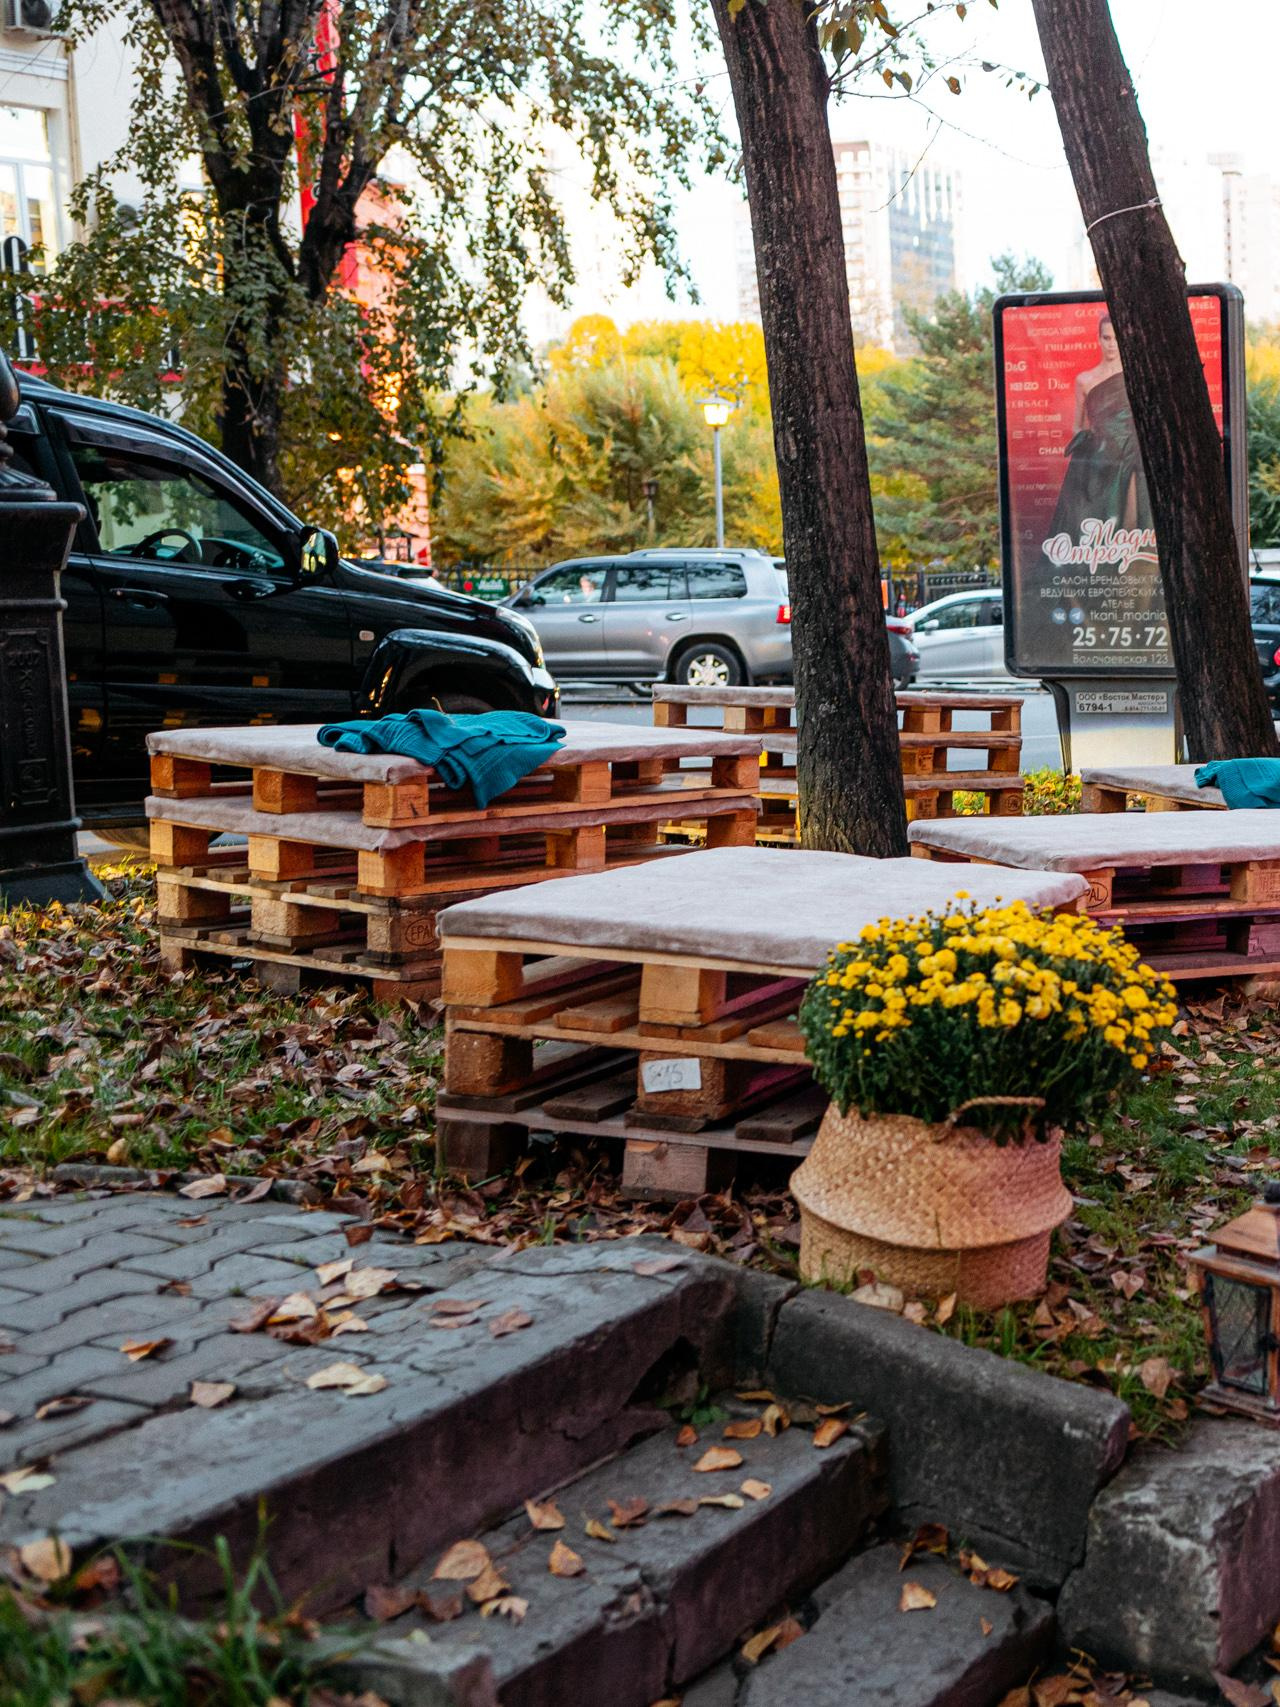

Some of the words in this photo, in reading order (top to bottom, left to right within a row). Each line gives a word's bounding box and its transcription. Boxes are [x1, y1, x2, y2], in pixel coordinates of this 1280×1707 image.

[1048, 378, 1070, 390] Dior
[1012, 430, 1063, 439] ETRO
[1039, 446, 1065, 455] CHAN
[1081, 518, 1157, 555] Модн
[1042, 533, 1158, 574] Отрез
[1052, 575, 1088, 586] САЛОН
[1090, 575, 1149, 586] БРЕНДОВЫХ
[1040, 587, 1086, 599] ВЕДУЩИХ
[1088, 585, 1159, 598] ЕВРОПЕЙСКИХ
[1101, 600, 1135, 609] АТЕЛЬЕ
[1073, 653, 1148, 665] Волочаевская
[1151, 653, 1169, 665] 123
[1078, 693, 1097, 701] ООО
[1079, 703, 1113, 712] 6794-1
